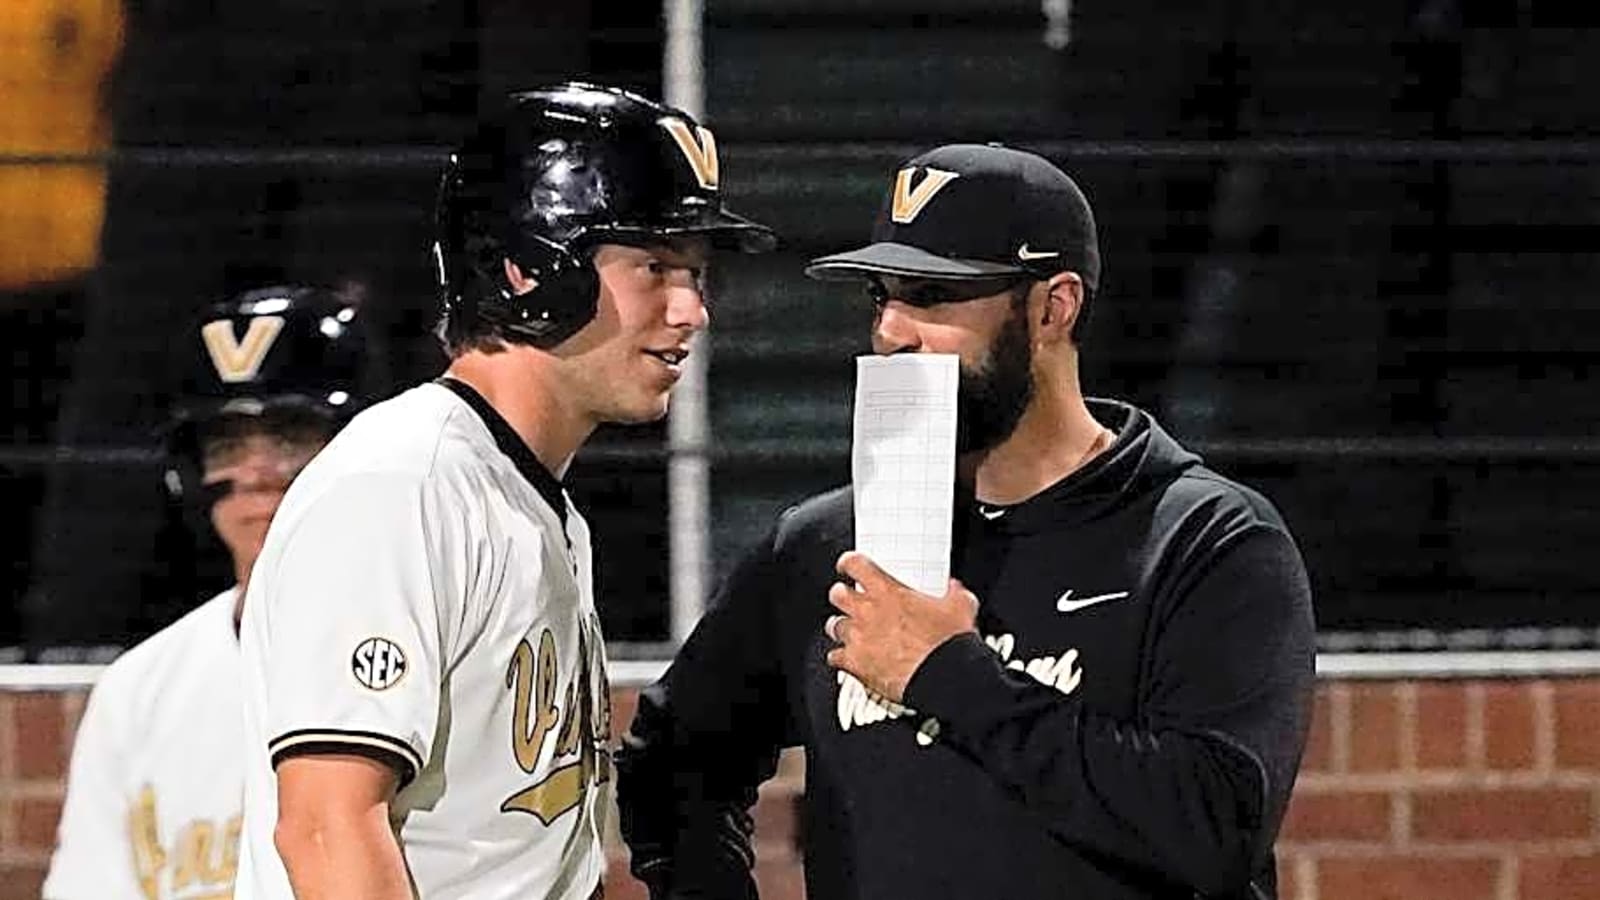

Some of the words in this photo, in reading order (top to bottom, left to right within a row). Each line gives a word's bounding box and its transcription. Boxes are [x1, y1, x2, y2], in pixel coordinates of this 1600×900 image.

[656, 116, 720, 191] V
[892, 166, 960, 224] V
[201, 315, 286, 383] V
[352, 638, 406, 690] SEC
